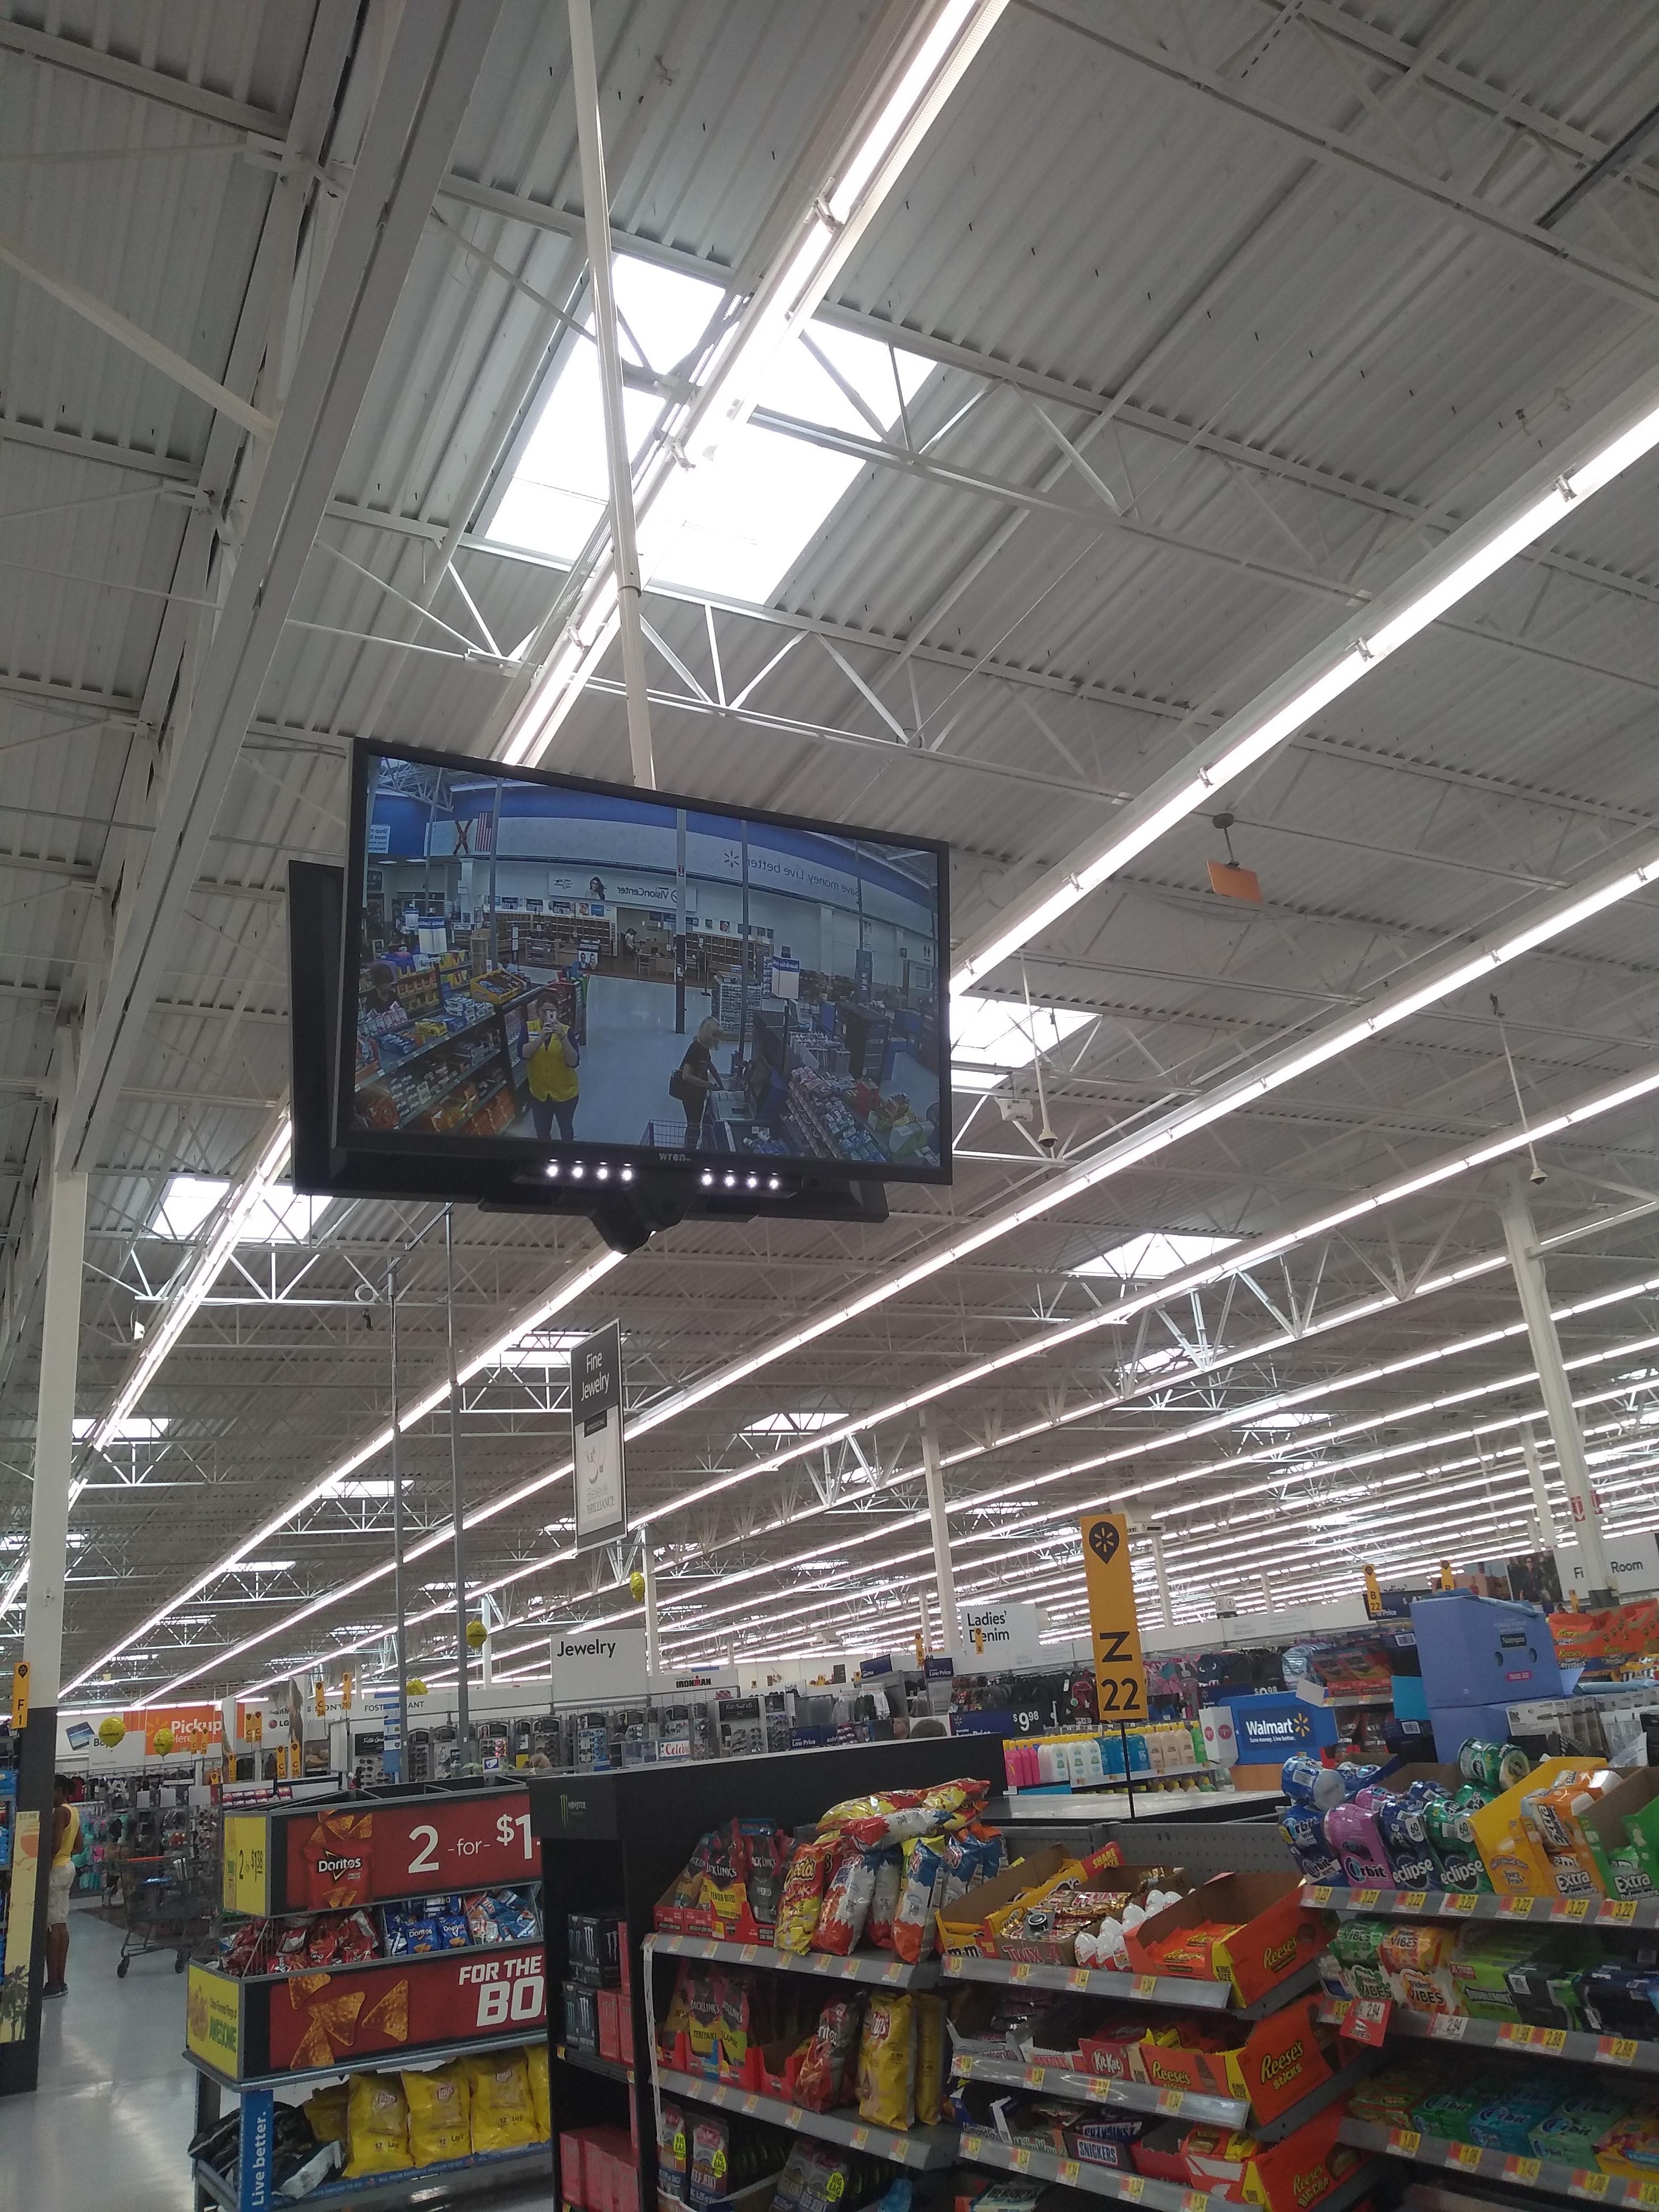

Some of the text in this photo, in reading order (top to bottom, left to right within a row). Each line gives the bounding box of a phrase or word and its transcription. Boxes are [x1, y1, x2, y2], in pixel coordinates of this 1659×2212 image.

[586, 1351, 602, 1374] Fine
[581, 1372, 610, 1402] Jewelry
[587, 1496, 615, 1515] BRILLIANCE
[1611, 1560, 1644, 1574] Room
[968, 1610, 1007, 1627] Ladies'
[557, 1639, 616, 1658] Jewelry
[1100, 1631, 1133, 1663] Z
[1101, 1678, 1141, 1711] 22
[18, 1699, 24, 1711] F
[19, 1715, 22, 1725] 1
[171, 1720, 222, 1735] Pickup
[1246, 1718, 1294, 1735] Walmart
[1410, 1822, 1419, 1834] 60
[1459, 1821, 1469, 1834] 60
[408, 1825, 439, 1874] 2
[319, 1857, 362, 1873] Doritos
[1093, 1848, 1117, 1869] SHARE
[1392, 1859, 1434, 1883] eclipse
[1440, 1859, 1485, 1885] eclipse
[1555, 1871, 1590, 1890] Extra
[1613, 1872, 1652, 1893] Extra
[1364, 1892, 1377, 1904] 3.22
[1409, 1893, 1422, 1906] 3.22
[1459, 1899, 1472, 1909] 3.22
[1514, 1898, 1531, 1911] 3.22
[1570, 1901, 1585, 1914] 3.22
[1616, 1904, 1632, 1916] 3.22
[1391, 1936, 1418, 1948] VIBES
[1263, 1936, 1297, 1970] Reese's
[459, 1955, 543, 1985] FOR THE
[1216, 1965, 1230, 1974] KING
[1218, 1973, 1233, 1982] SIZE
[1358, 1984, 1392, 1999] VIBES
[1410, 1991, 1444, 2005] VIBES
[1261, 2040, 1304, 2084] Reese's
[1152, 2060, 1191, 2085] Reese's
[1234, 2090, 1247, 2099] SIZE
[675, 2135, 684, 2144] BIG
[675, 2143, 685, 2152] BAG
[1079, 2141, 1116, 2163] SNICKERS
[252, 2111, 265, 2206] Live better.
[715, 2153, 724, 2162] BIG
[713, 2161, 725, 2171] BAG
[832, 2176, 842, 2186] BIG
[828, 2184, 841, 2194] BAG
